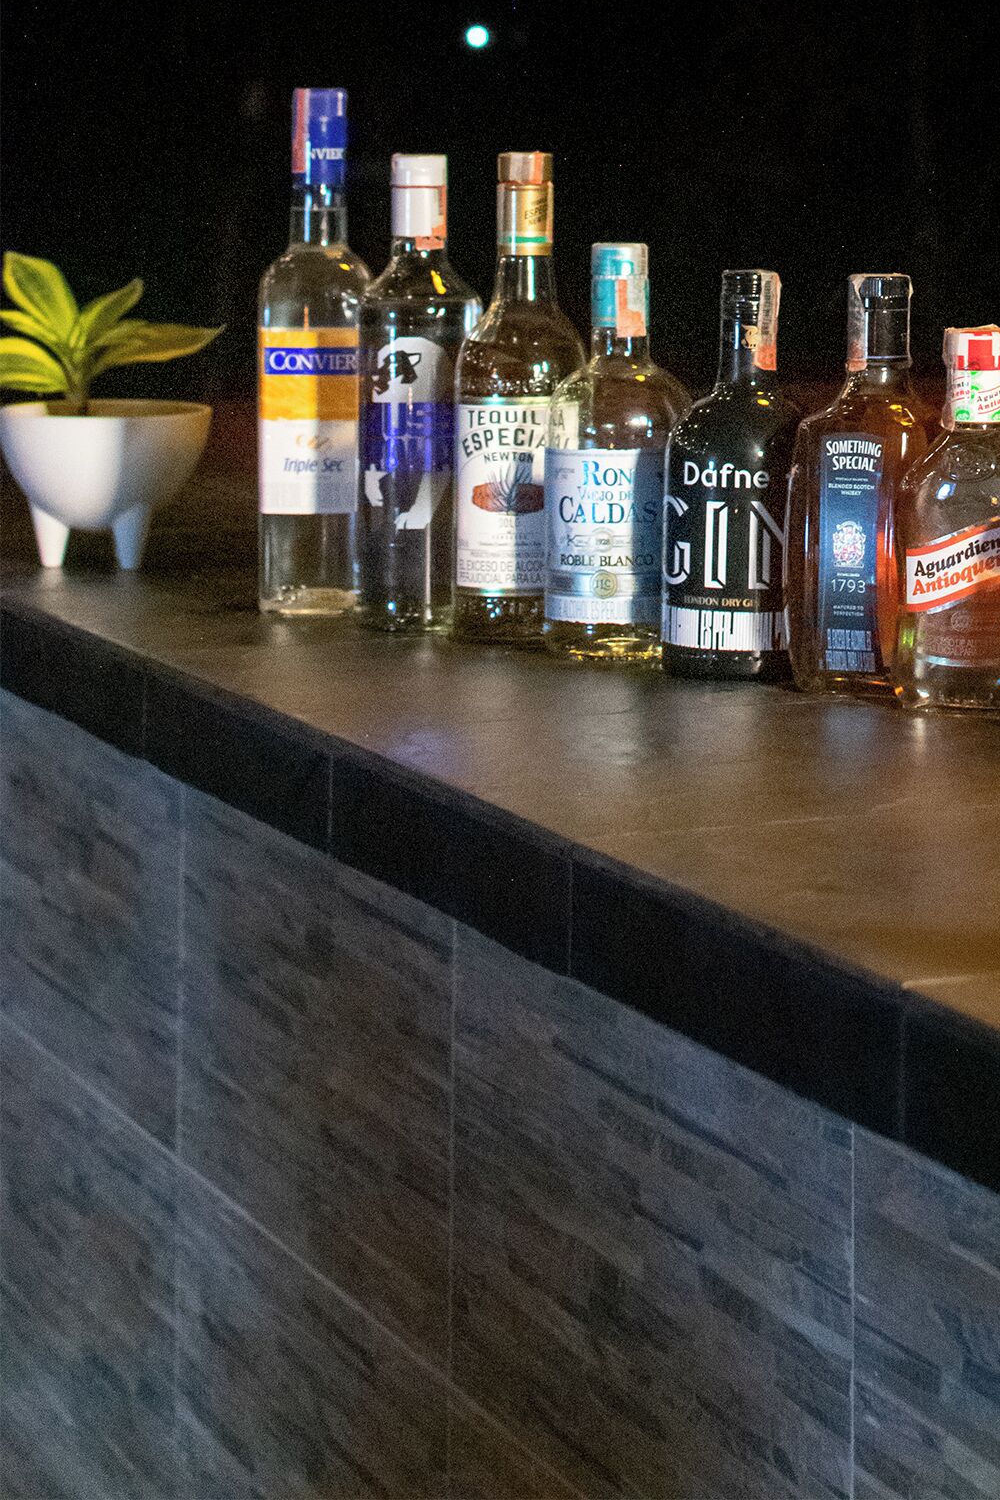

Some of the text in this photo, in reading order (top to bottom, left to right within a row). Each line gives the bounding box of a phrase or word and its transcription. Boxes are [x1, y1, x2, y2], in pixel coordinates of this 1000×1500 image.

[484, 451, 535, 463] NEWTON
[825, 440, 882, 458] SOMETHING
[284, 457, 345, 473] Triple Sec
[832, 455, 876, 472] SPECIAL
[684, 461, 769, 489] Dafne
[560, 495, 658, 524] CALDAS
[663, 494, 786, 590] GIN
[560, 553, 595, 566] ROBLE
[600, 554, 654, 567] BLANCO
[831, 579, 866, 594] 1793
[721, 598, 741, 607] DRY
[742, 598, 758, 607] GI
